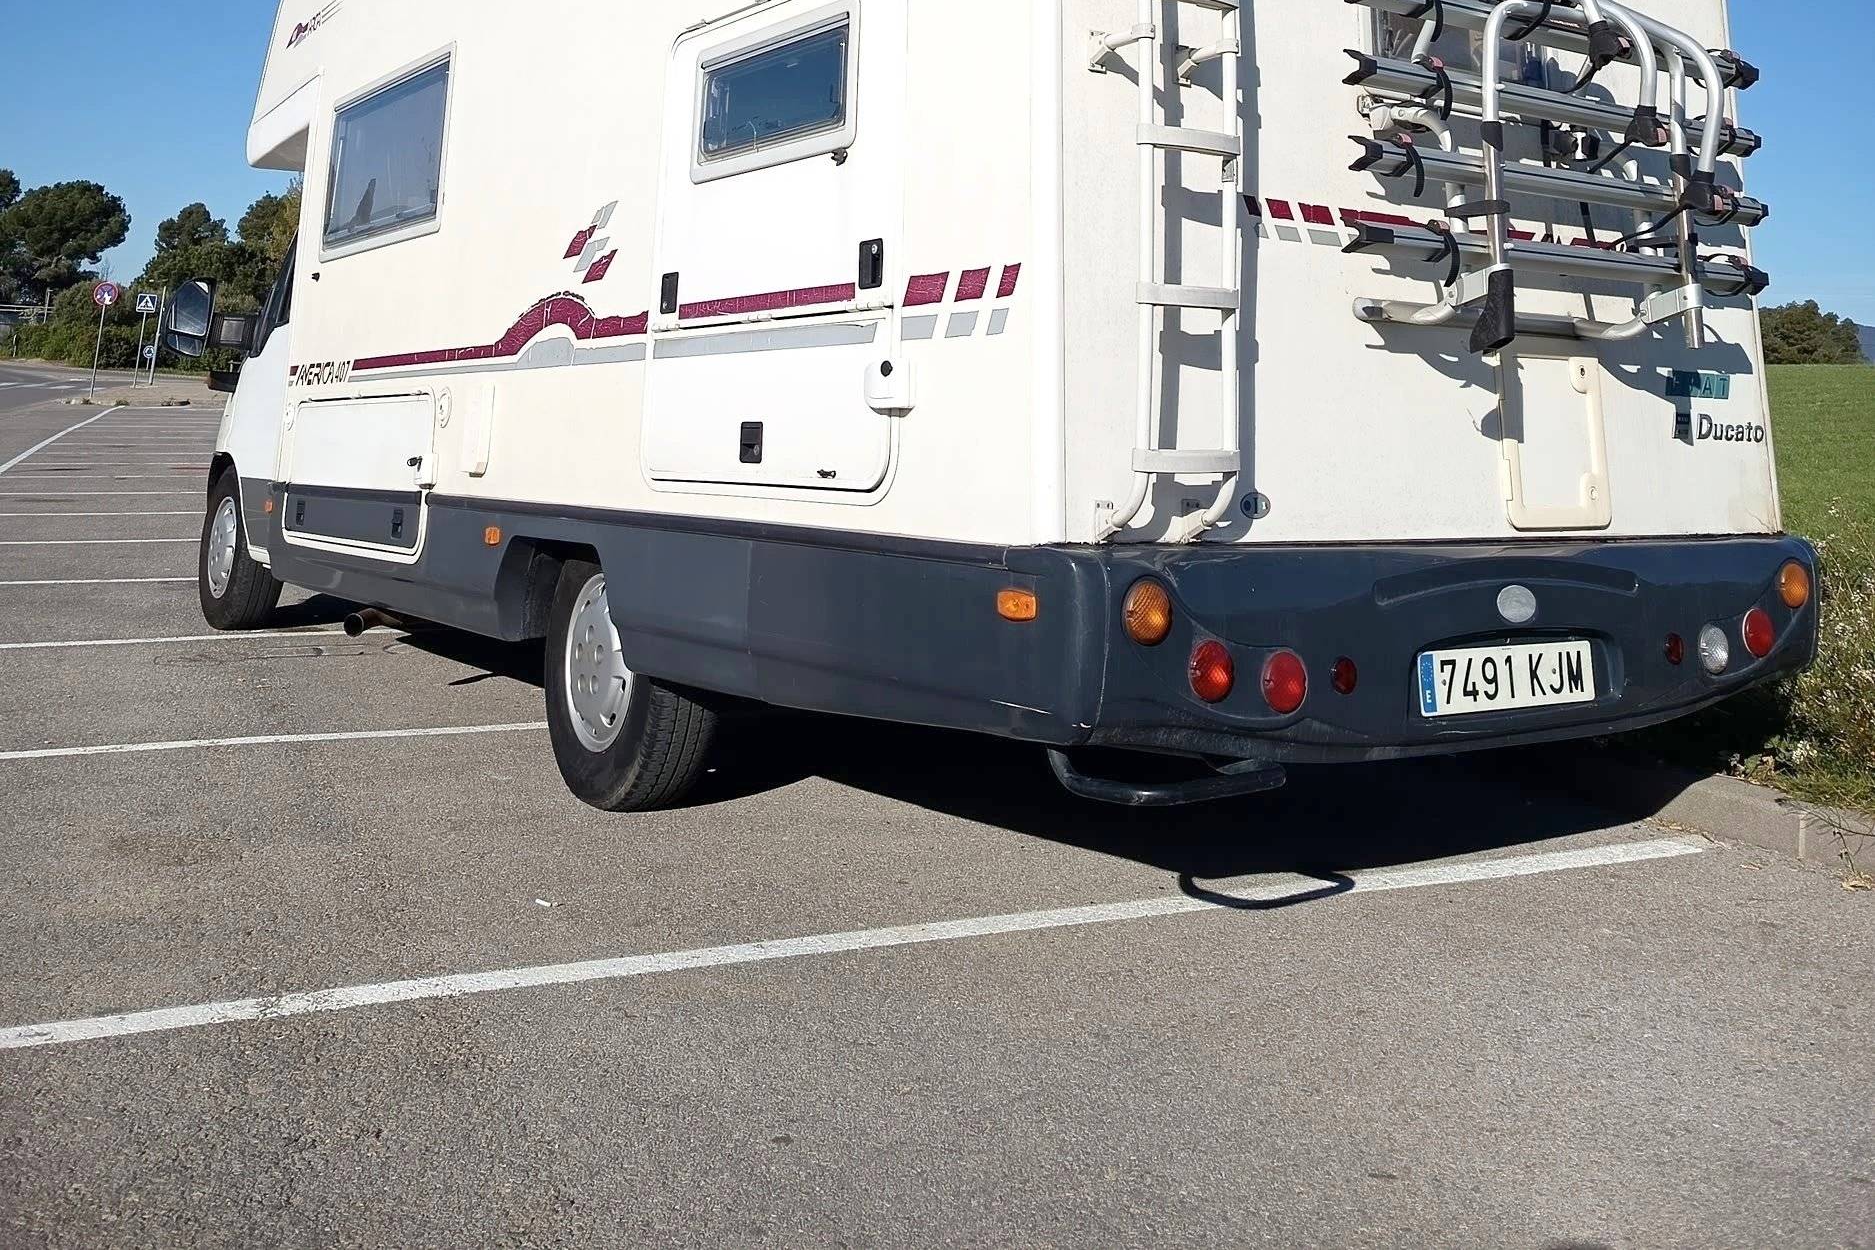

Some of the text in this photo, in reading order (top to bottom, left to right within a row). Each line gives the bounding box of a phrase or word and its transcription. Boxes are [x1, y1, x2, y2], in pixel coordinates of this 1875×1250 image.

[1696, 413, 1765, 443] Ducato
[1426, 651, 1585, 704] E 7491 KJM
